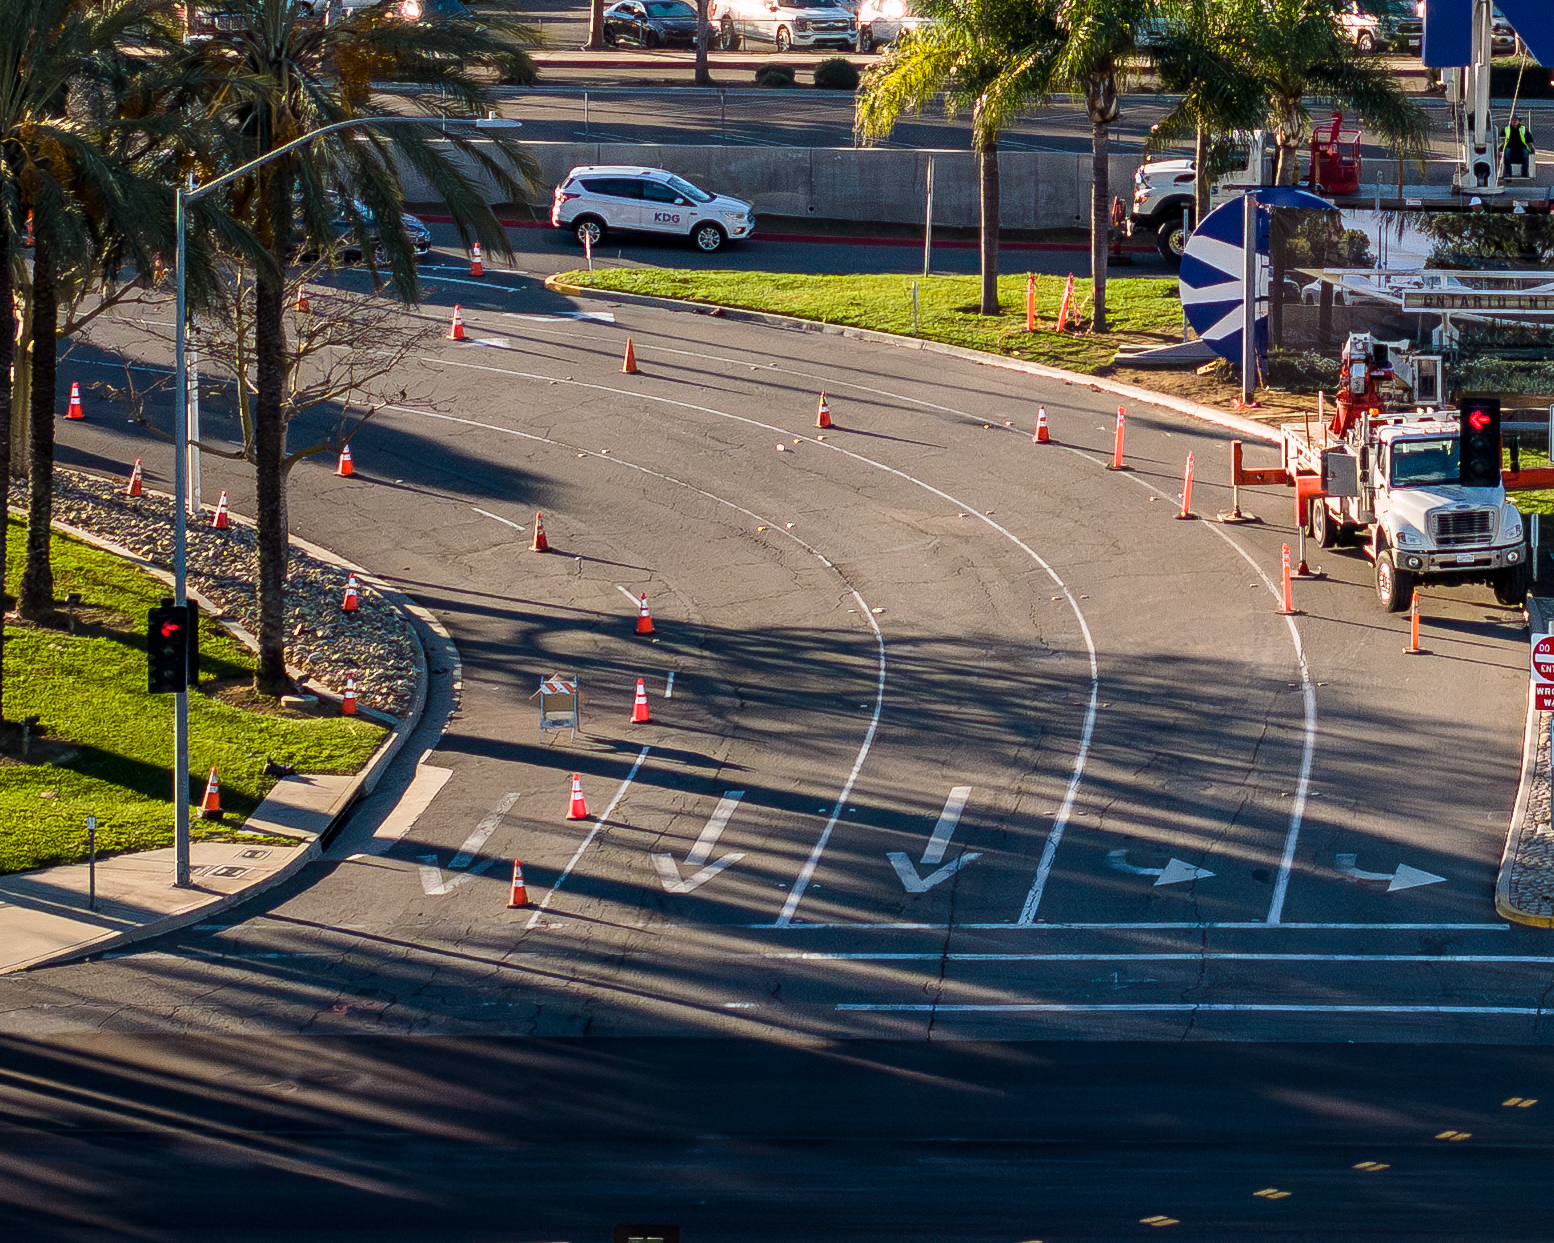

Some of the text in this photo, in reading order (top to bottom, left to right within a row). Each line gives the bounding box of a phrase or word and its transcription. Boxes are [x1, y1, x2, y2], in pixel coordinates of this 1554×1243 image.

[654, 212, 680, 223] KDG
[1423, 294, 1508, 309] ONTARIO
[1539, 643, 1551, 653] DO
